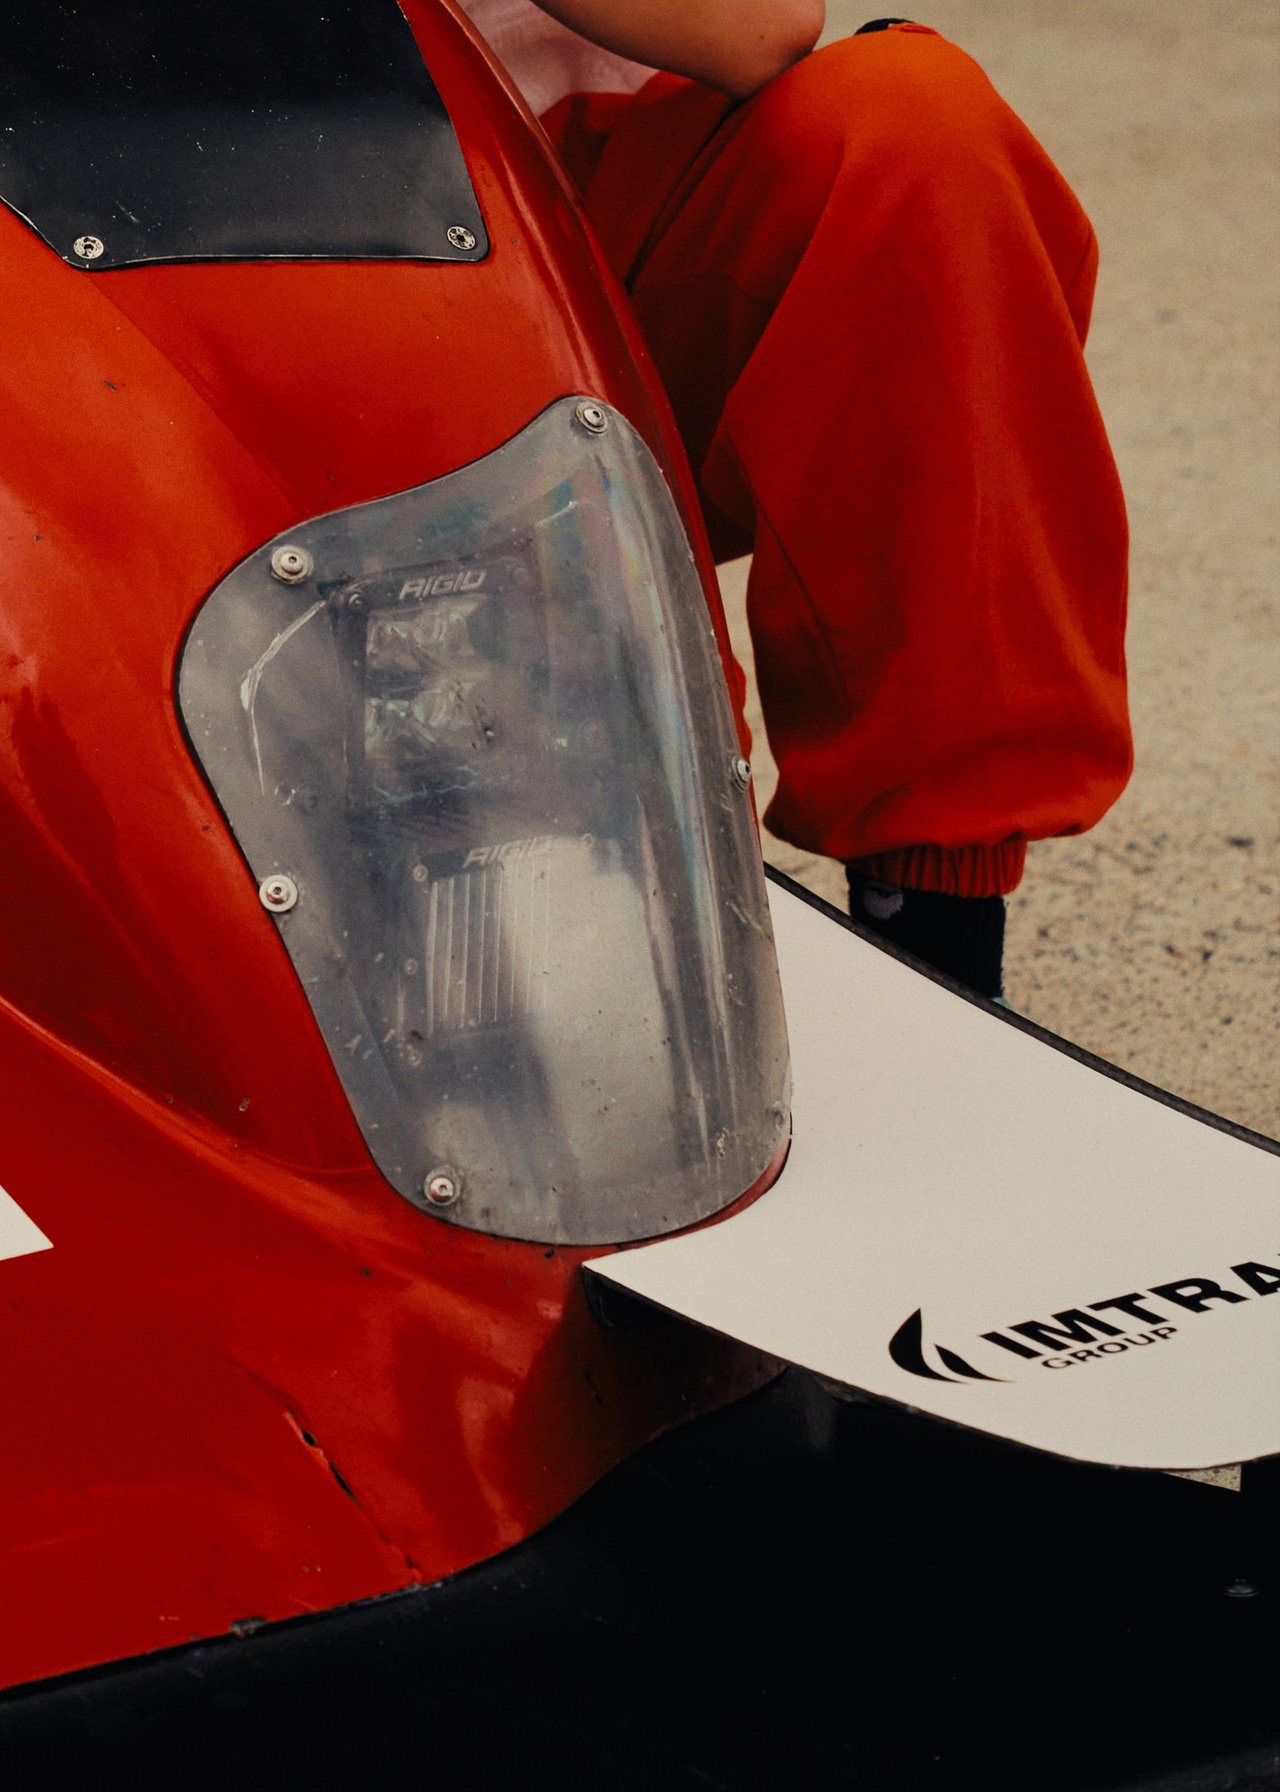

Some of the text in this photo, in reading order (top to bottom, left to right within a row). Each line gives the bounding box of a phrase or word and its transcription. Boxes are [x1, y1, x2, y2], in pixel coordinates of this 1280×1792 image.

[398, 570, 488, 600] RIGID
[979, 1253, 1280, 1360] IMTRA
[1041, 1326, 1179, 1369] GROUP
